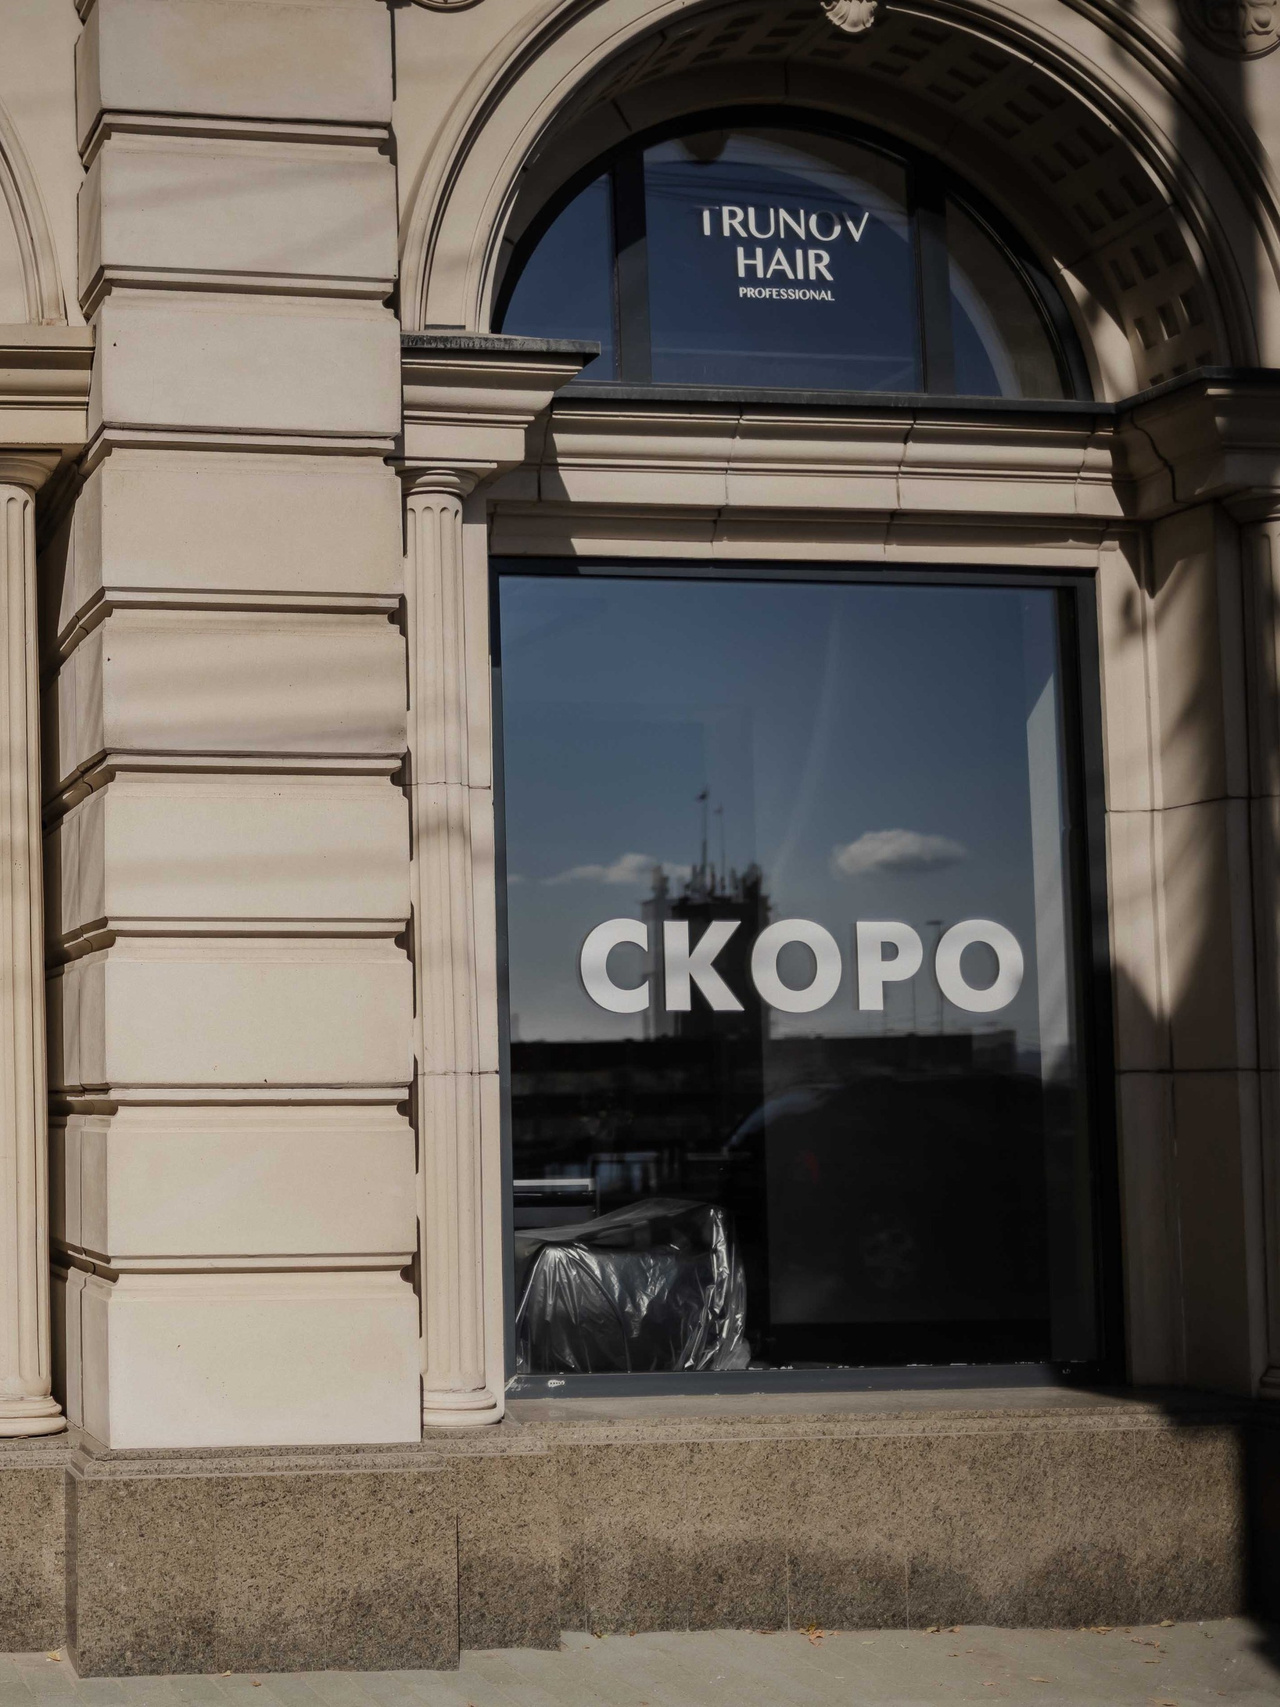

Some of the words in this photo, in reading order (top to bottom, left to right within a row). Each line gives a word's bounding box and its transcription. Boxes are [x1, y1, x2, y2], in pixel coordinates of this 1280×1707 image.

[695, 204, 870, 243] TRUNOV
[736, 246, 834, 282] HAIR
[738, 286, 836, 302] PROFESSIONAL
[580, 917, 1024, 1014] СКОРО
